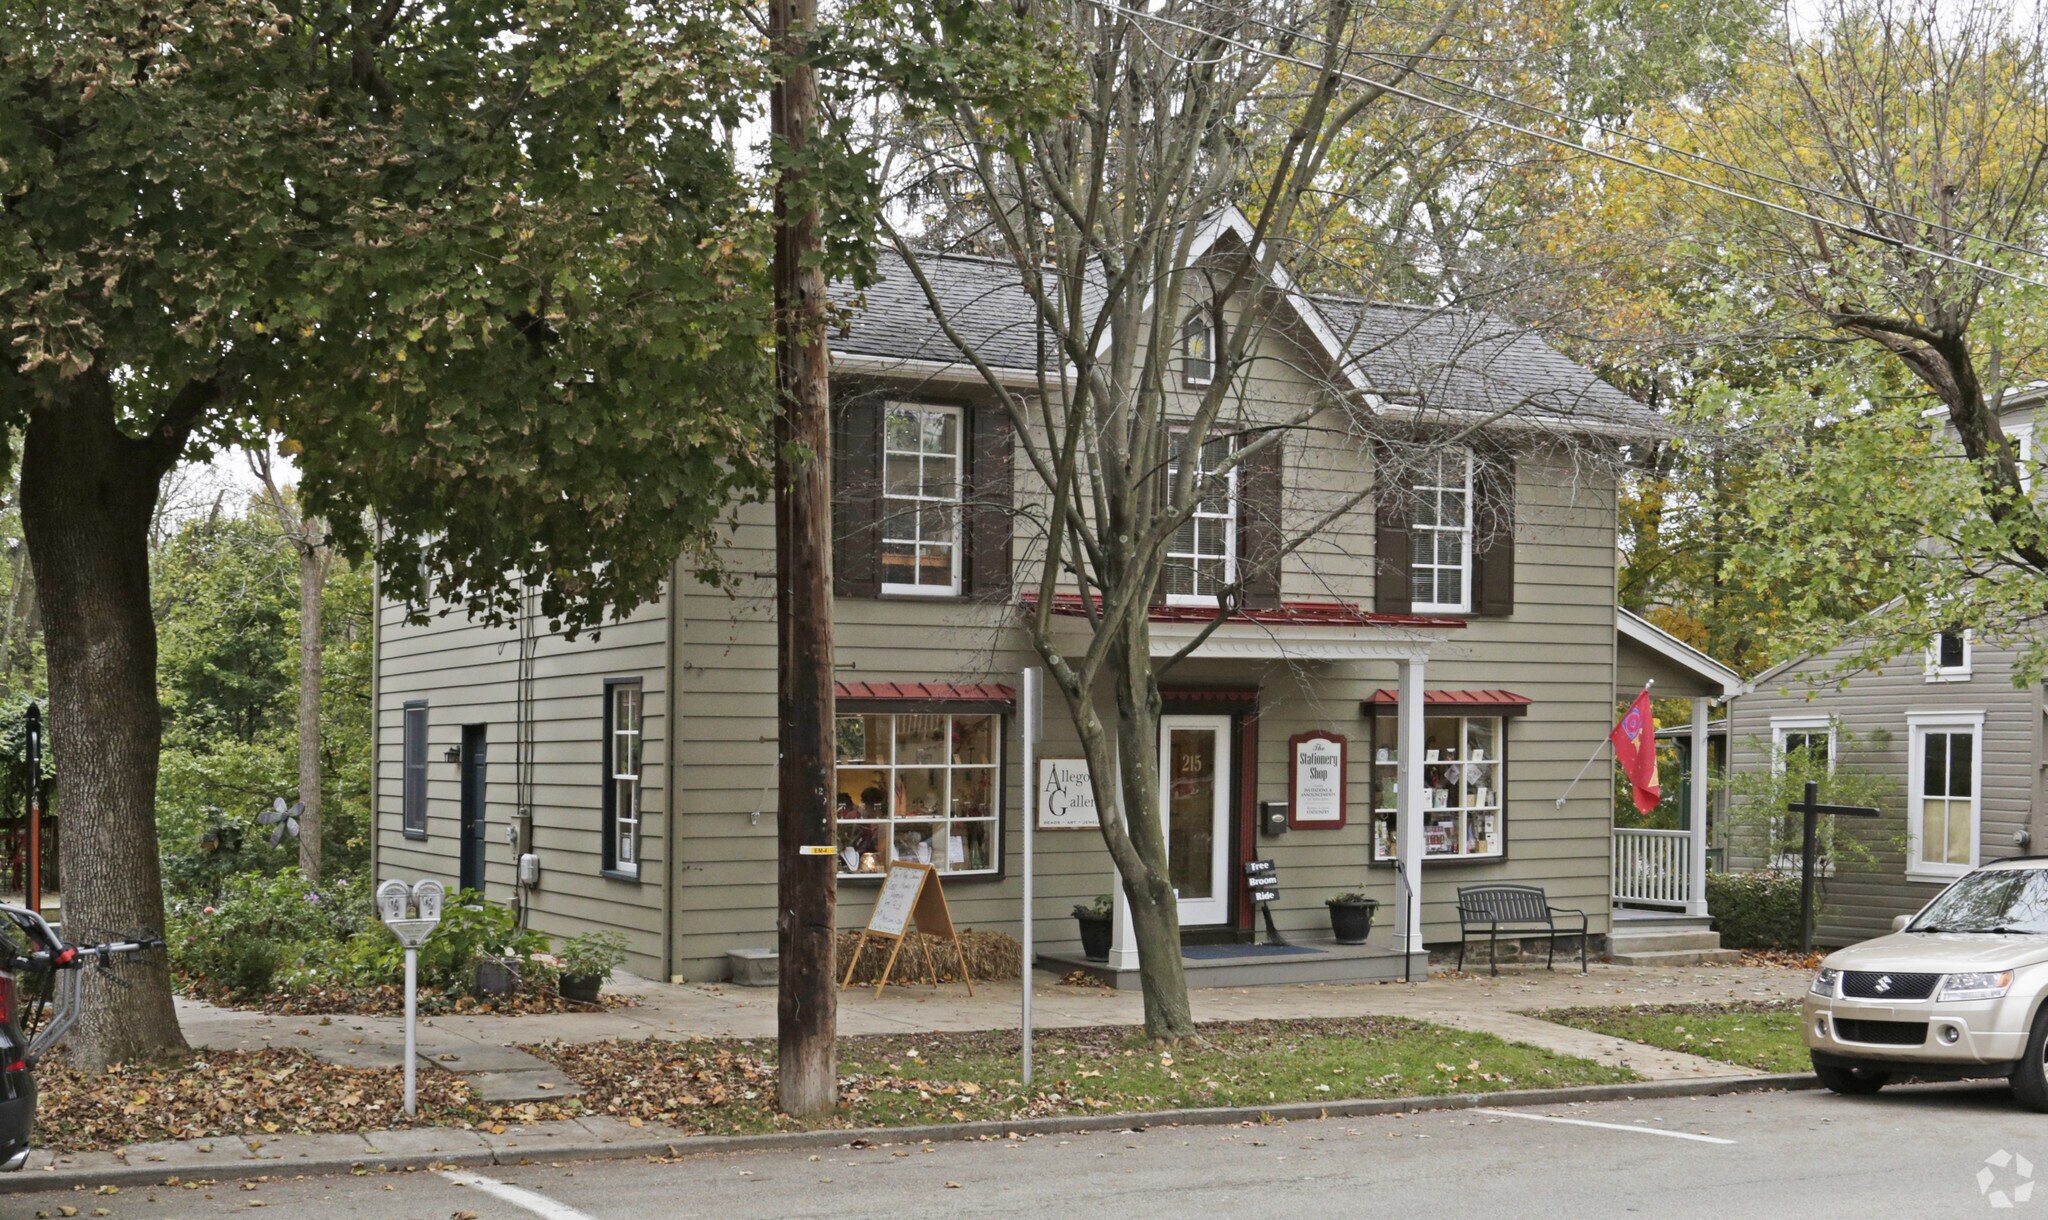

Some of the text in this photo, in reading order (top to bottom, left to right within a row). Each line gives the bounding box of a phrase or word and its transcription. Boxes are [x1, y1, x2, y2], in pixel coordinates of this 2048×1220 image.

[1312, 743, 1325, 751] The
[1182, 755, 1202, 772] 215
[1299, 752, 1338, 767] Stationery
[1044, 762, 1091, 792] Allego
[1309, 767, 1328, 781] Shop
[1048, 787, 1094, 816] Galler
[1251, 862, 1270, 871] Free
[1248, 877, 1277, 886] Broom
[1255, 891, 1275, 900] Ride
